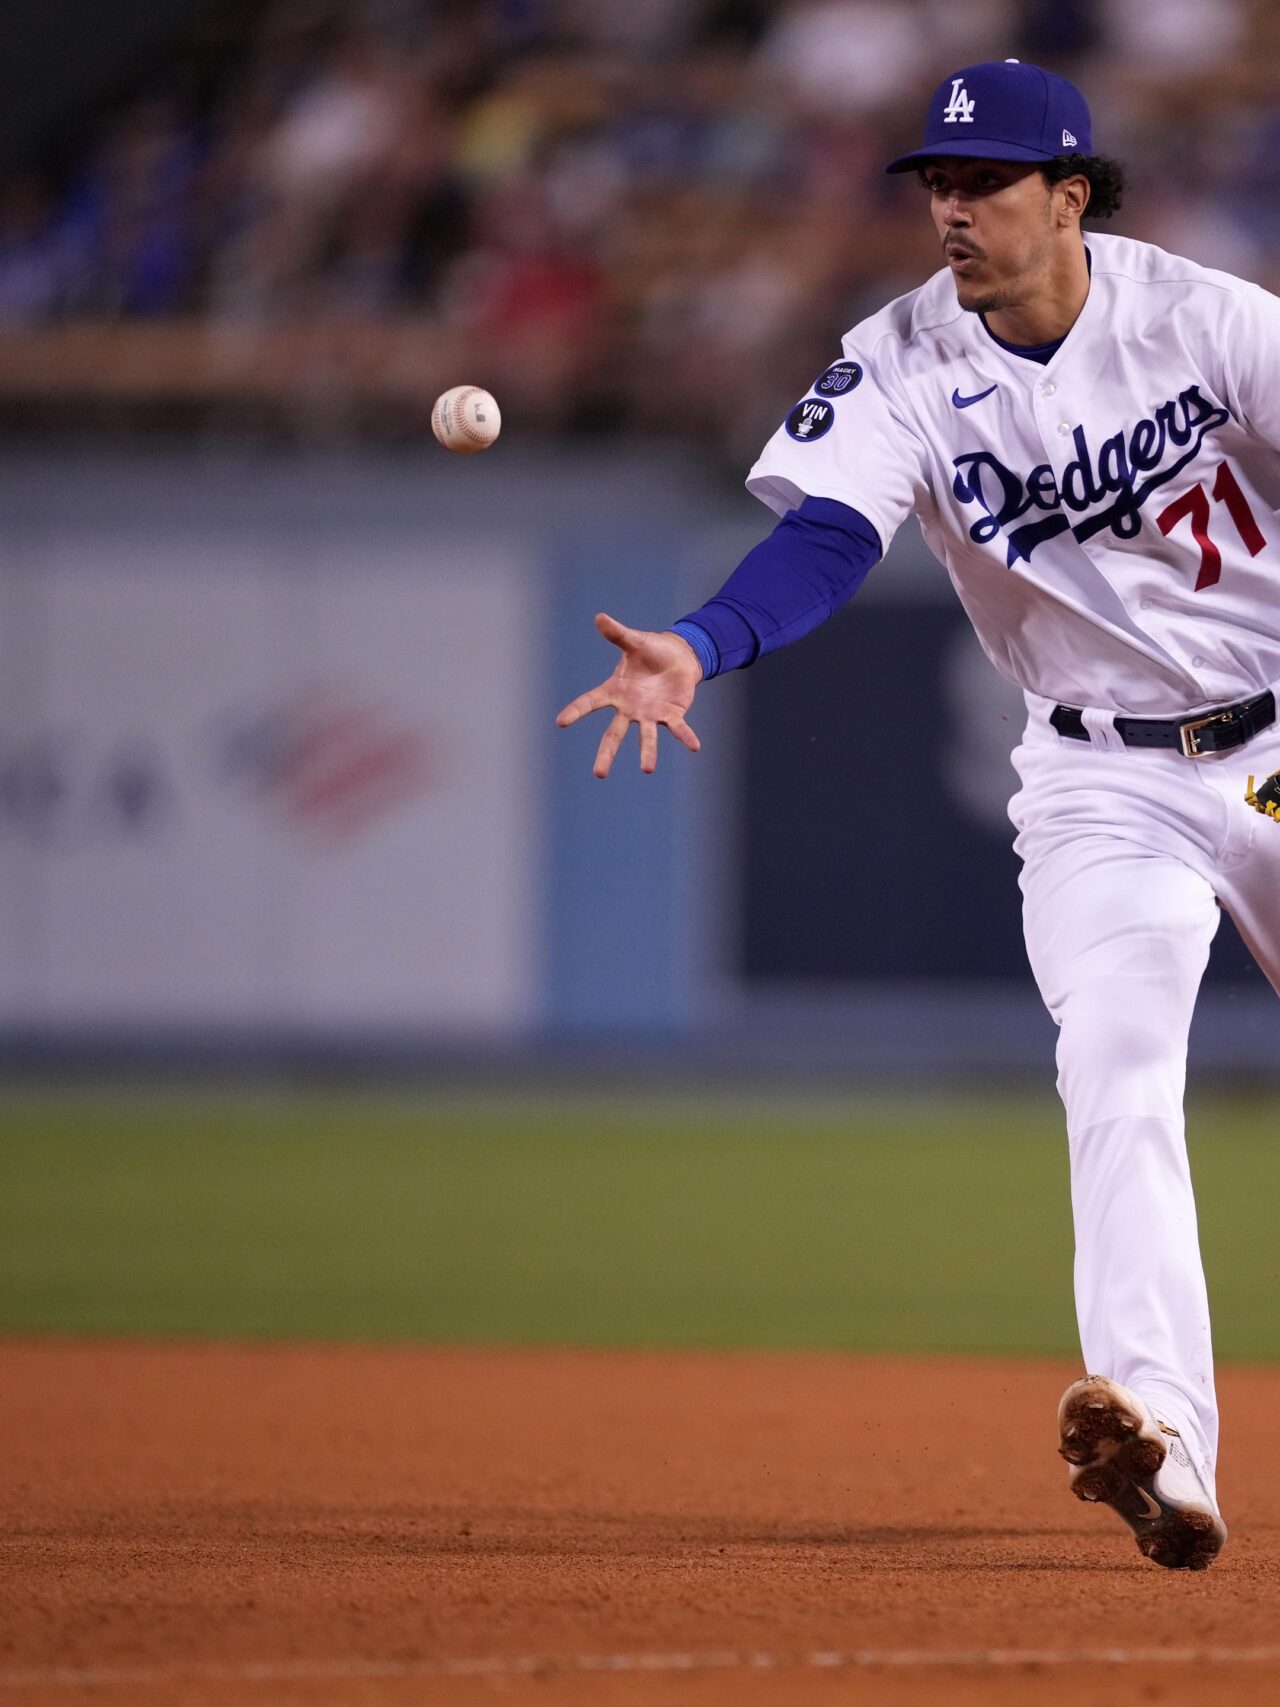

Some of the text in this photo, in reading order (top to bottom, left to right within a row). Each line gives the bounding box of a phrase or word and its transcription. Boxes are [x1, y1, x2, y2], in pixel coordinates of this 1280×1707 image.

[943, 78, 976, 123] LA
[821, 372, 852, 391] 30
[802, 403, 828, 421] VIN
[952, 384, 1229, 542] Dodgers
[1155, 459, 1267, 592] 71
